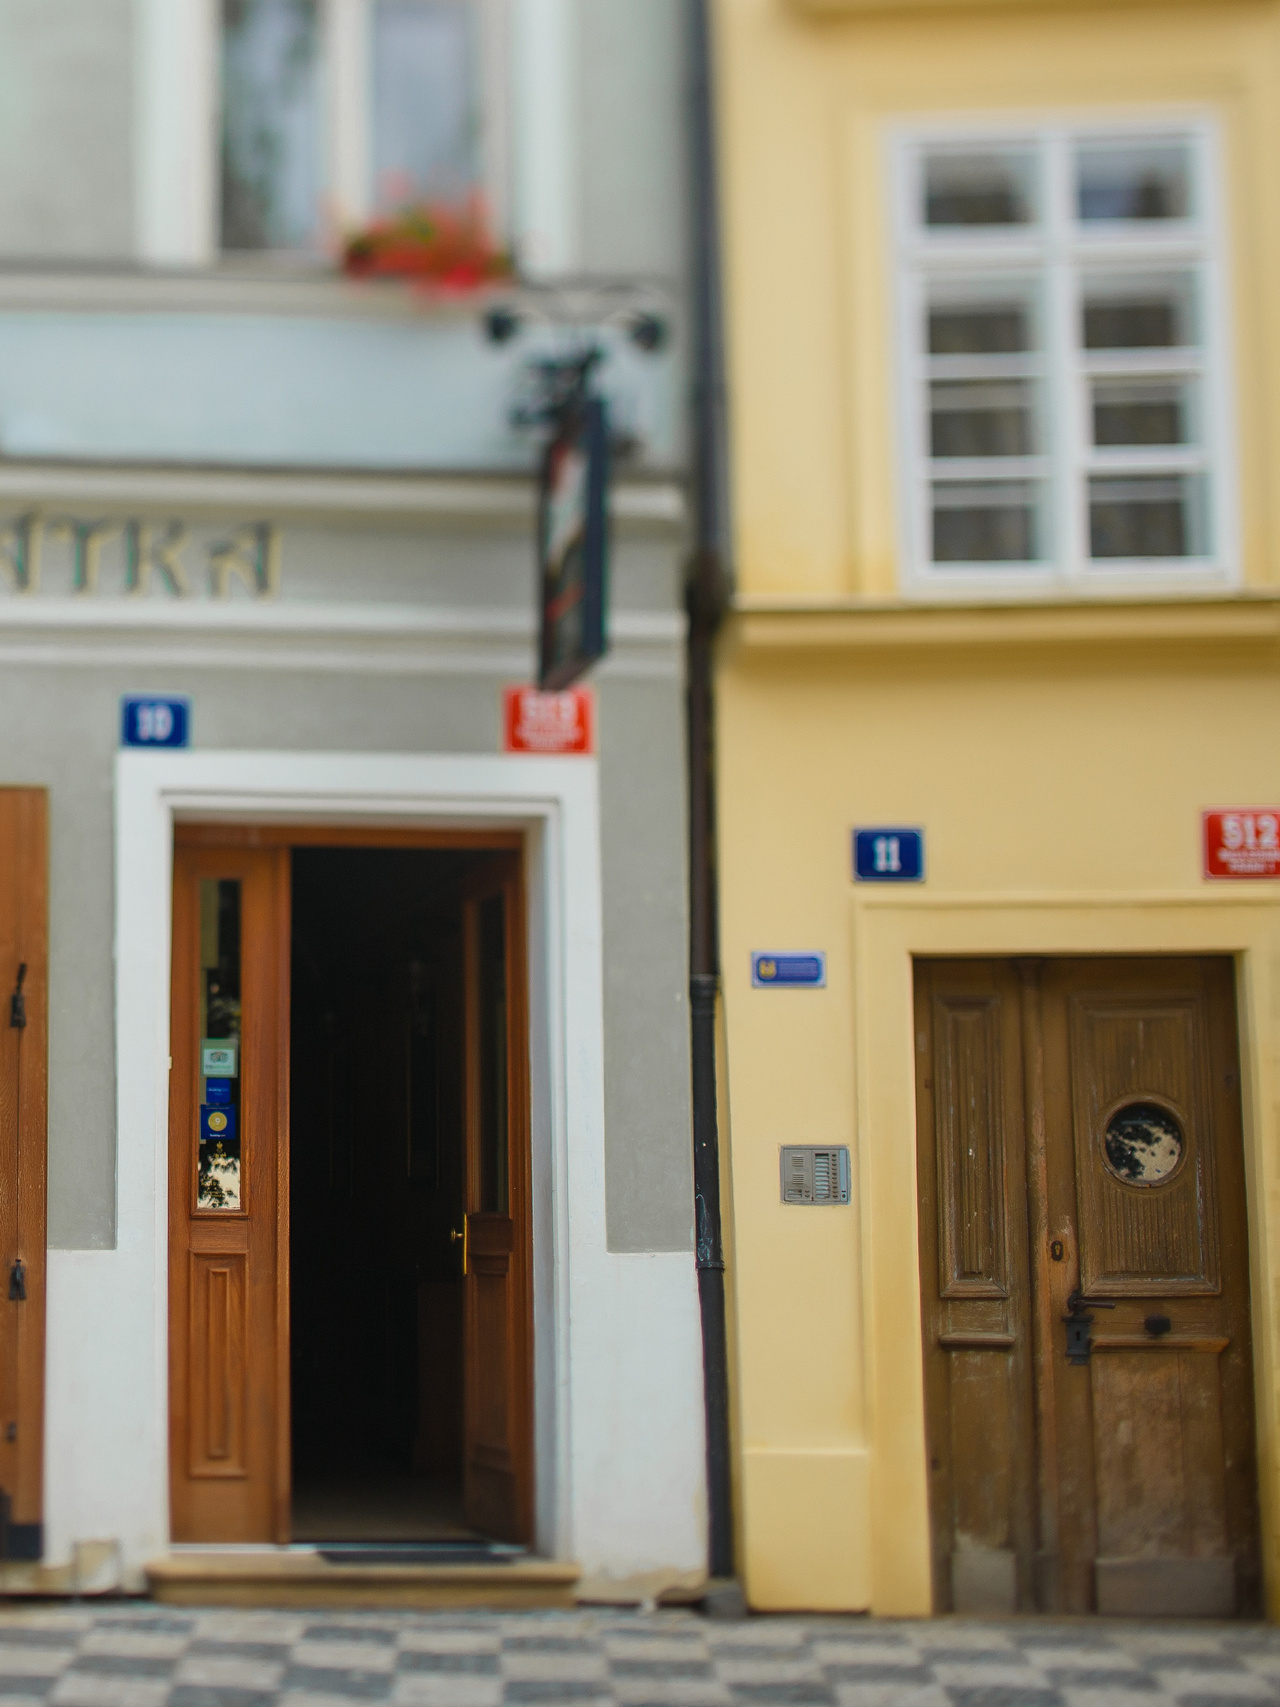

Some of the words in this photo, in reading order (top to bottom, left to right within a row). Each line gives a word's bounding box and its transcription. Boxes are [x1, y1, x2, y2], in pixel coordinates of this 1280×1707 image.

[1222, 814, 1278, 849] 512
[874, 835, 902, 872] 11
[214, 1117, 221, 1126] 9
